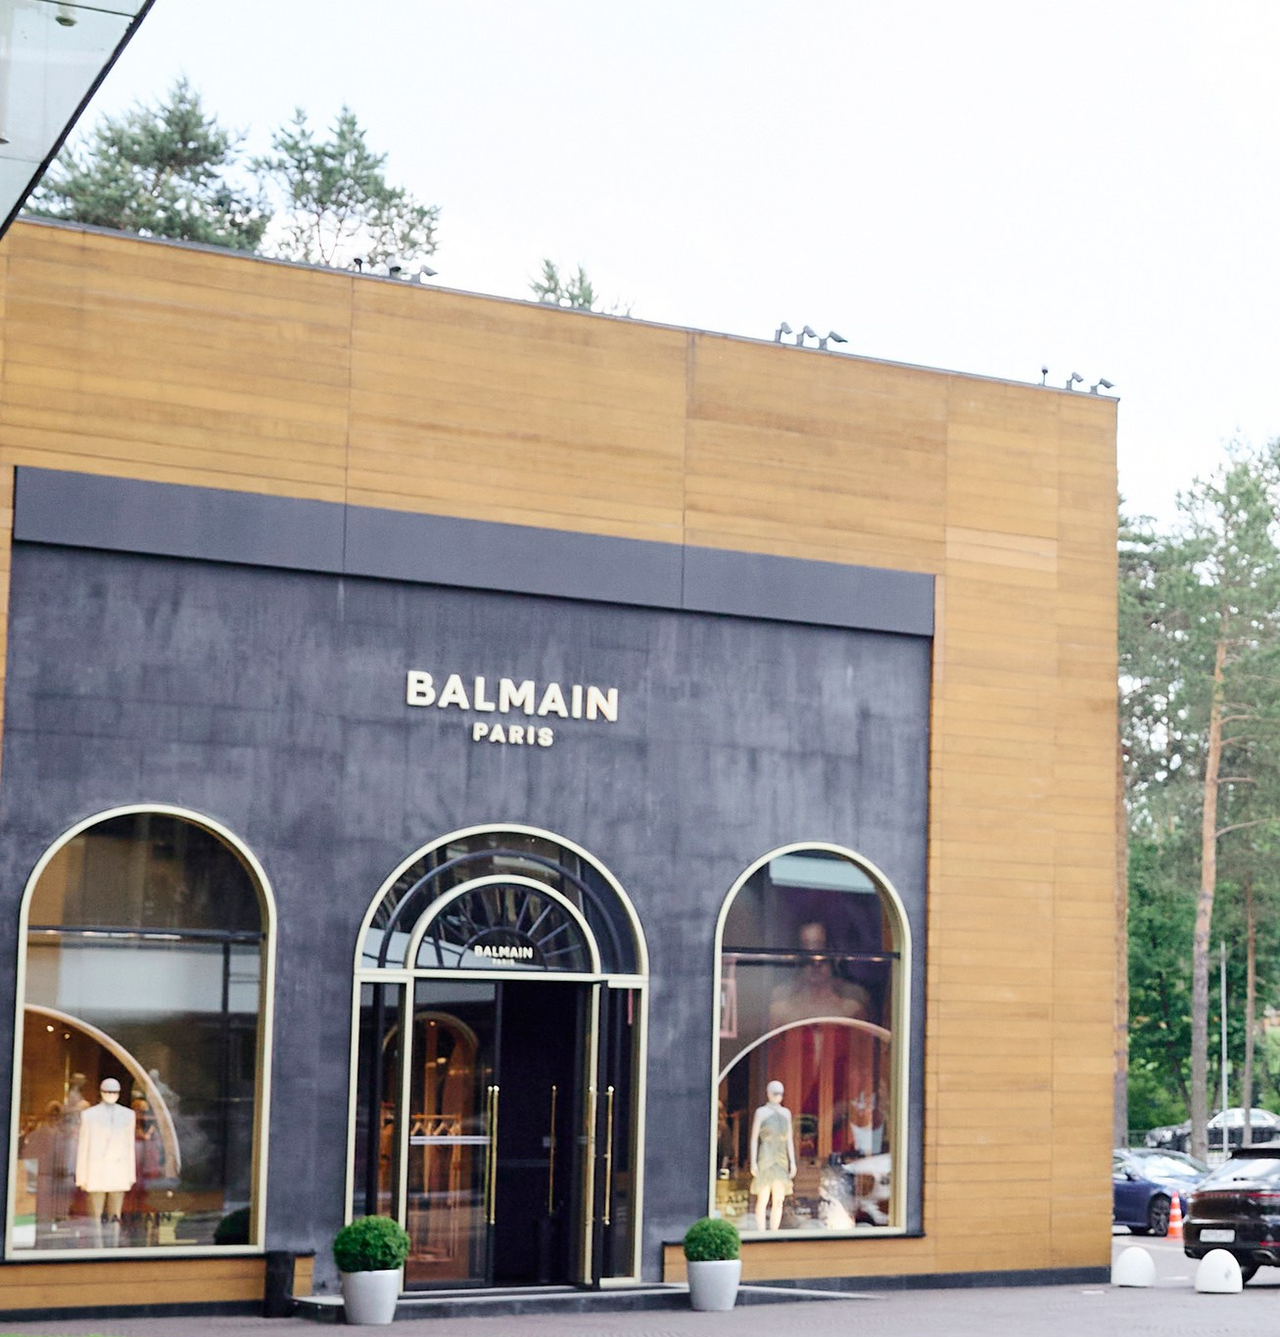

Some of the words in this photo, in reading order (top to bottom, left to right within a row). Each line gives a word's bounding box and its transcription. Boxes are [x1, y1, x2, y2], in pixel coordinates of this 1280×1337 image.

[406, 670, 619, 722] BALMAIN
[472, 721, 554, 747] PARIS
[474, 945, 533, 959] BALMAIN
